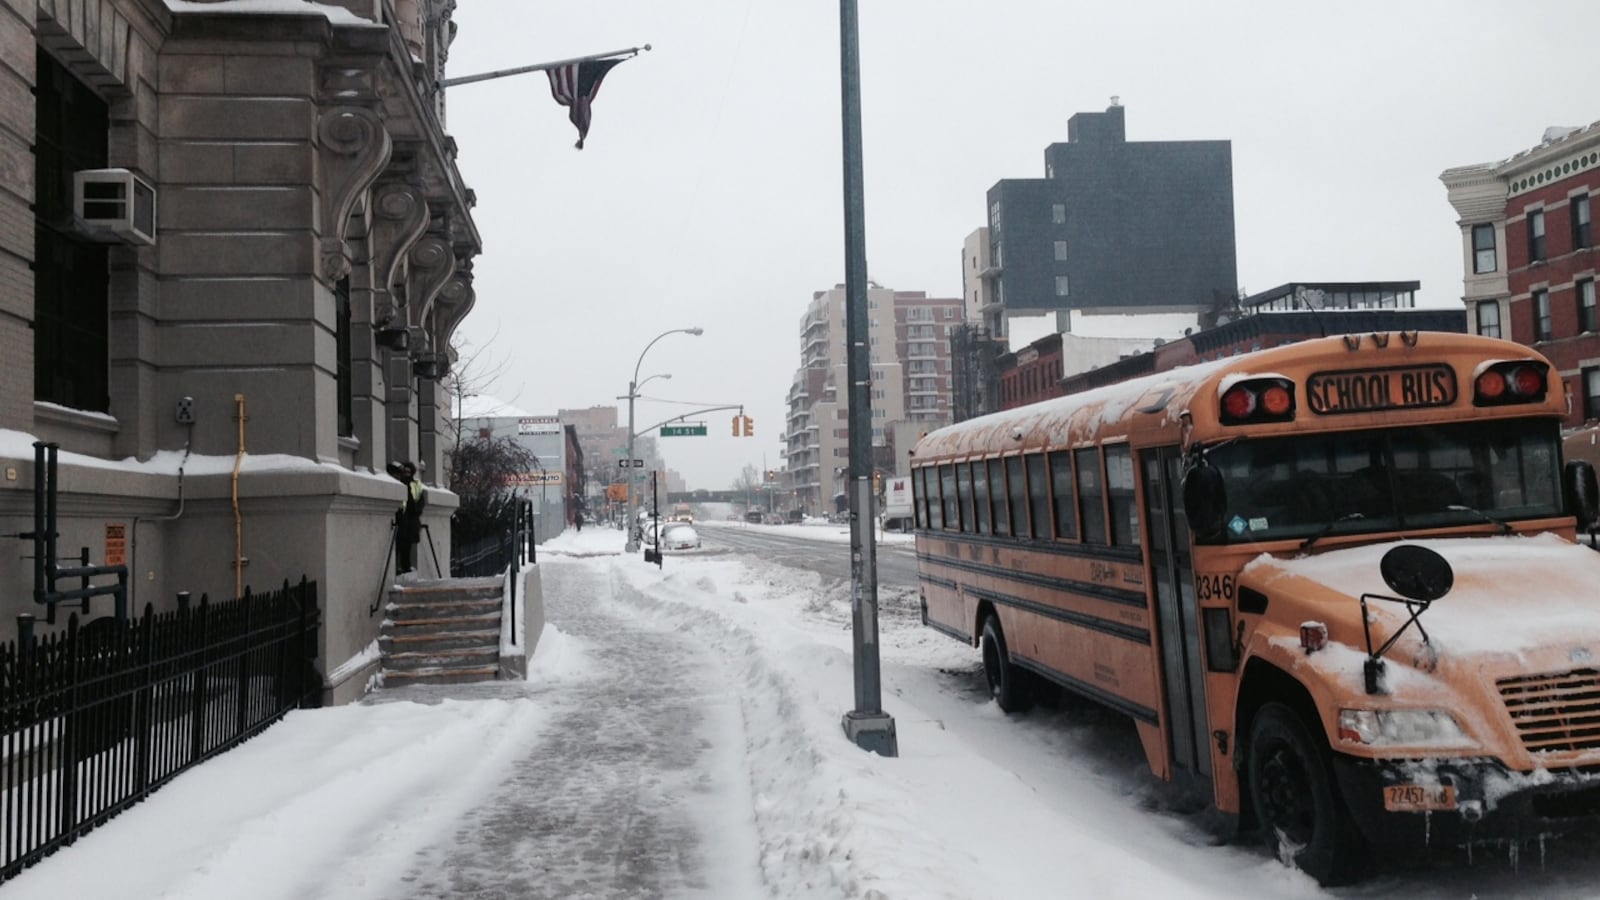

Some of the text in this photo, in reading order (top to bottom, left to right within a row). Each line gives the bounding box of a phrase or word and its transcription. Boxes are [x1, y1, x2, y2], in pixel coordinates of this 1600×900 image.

[1311, 370, 1448, 411] SCHOOL BUS
[1196, 574, 1233, 600] 2346
